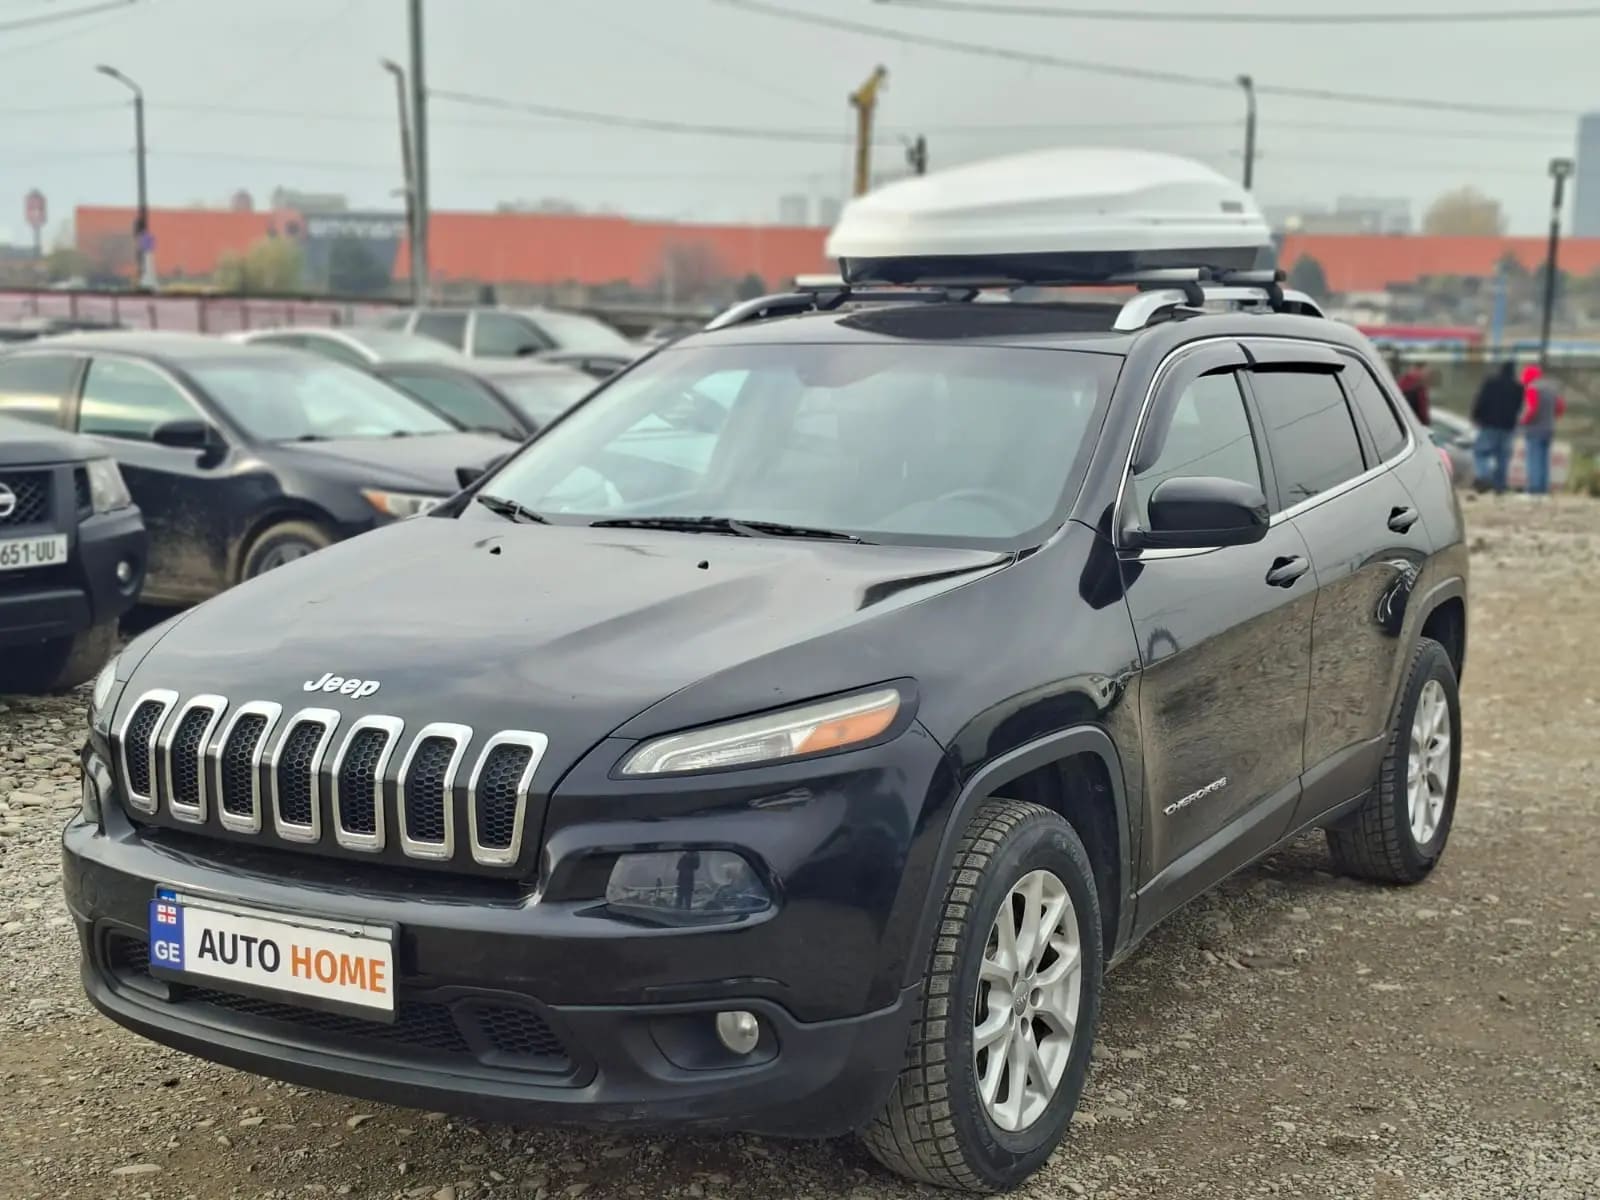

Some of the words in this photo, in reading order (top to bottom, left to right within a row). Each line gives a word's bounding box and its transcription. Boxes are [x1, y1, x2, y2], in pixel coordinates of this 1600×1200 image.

[303, 672, 380, 699] Jeep
[1163, 776, 1227, 816] CHEROKEE
[154, 940, 181, 963] GE
[198, 928, 281, 973] AUTO
[291, 944, 387, 994] HOME
